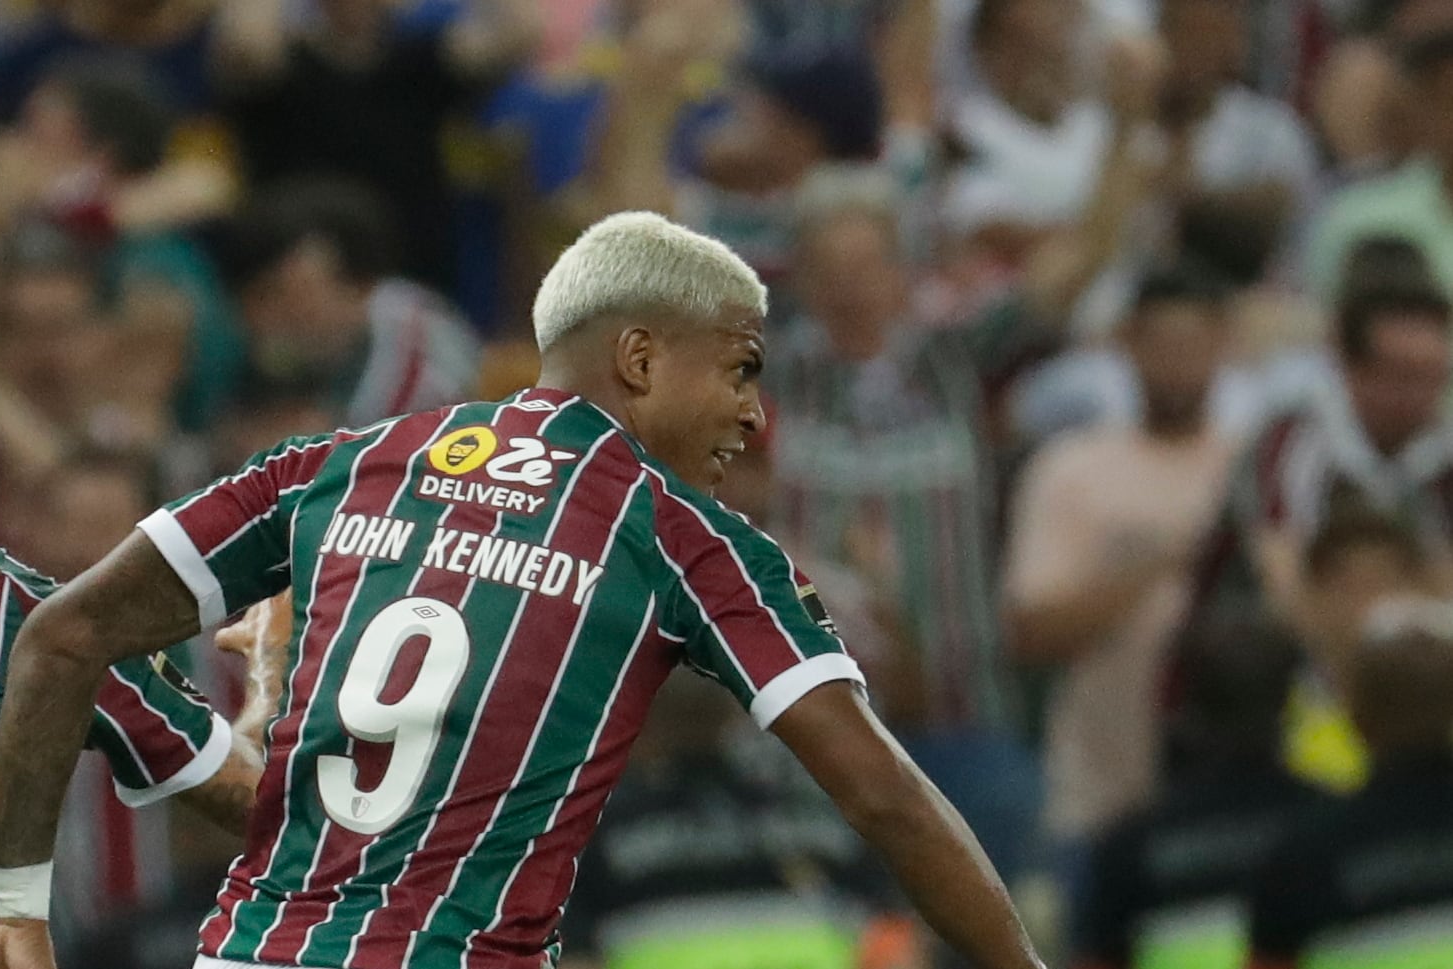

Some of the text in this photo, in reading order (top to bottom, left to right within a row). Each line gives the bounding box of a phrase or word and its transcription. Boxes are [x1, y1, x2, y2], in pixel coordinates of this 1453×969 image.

[419, 474, 545, 513] DELIVERY
[486, 437, 577, 487] Zé
[320, 512, 604, 606] JOHN KENNEDY
[316, 596, 470, 835] 9
